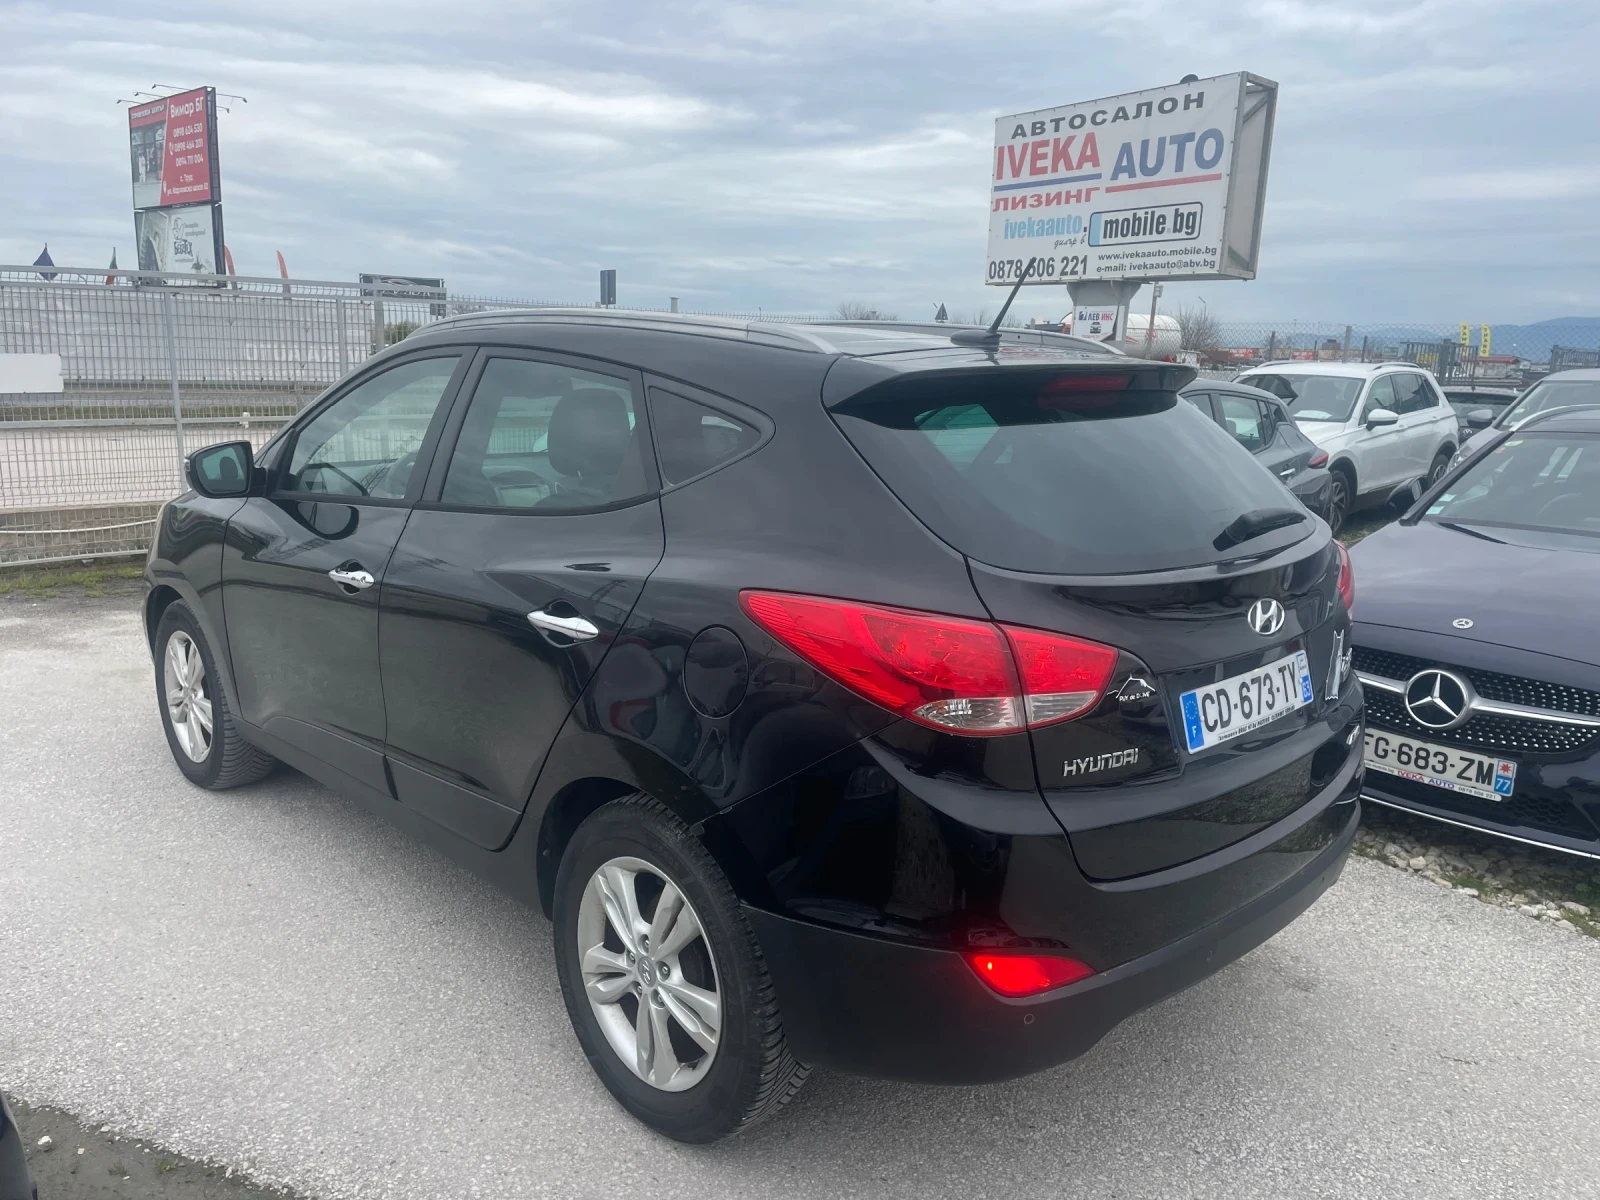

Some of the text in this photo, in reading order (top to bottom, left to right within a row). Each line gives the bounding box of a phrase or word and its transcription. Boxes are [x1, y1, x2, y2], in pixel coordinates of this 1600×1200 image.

[170, 97, 204, 119] Вимор БГ
[1011, 91, 1205, 139] АВТОСАЛОН
[995, 128, 1224, 181] IVEKA AUTO
[992, 187, 1099, 213] ЛИЗИНГ
[1102, 208, 1198, 239] mobile.bg
[1096, 258, 1216, 273] e-mail: ivekaauto@abv.bg
[1098, 246, 1217, 261] www.ivekaauto.mobile.bg
[988, 259, 1023, 280] 0878
[1060, 254, 1088, 277] 221
[1201, 661, 1299, 733] CD-673-TY
[1191, 725, 1198, 738] F
[1063, 748, 1139, 777] HYUNDAI
[1397, 770, 1425, 782] IVEKA
[1428, 777, 1455, 789] AUTO
[1495, 777, 1512, 792] 77
